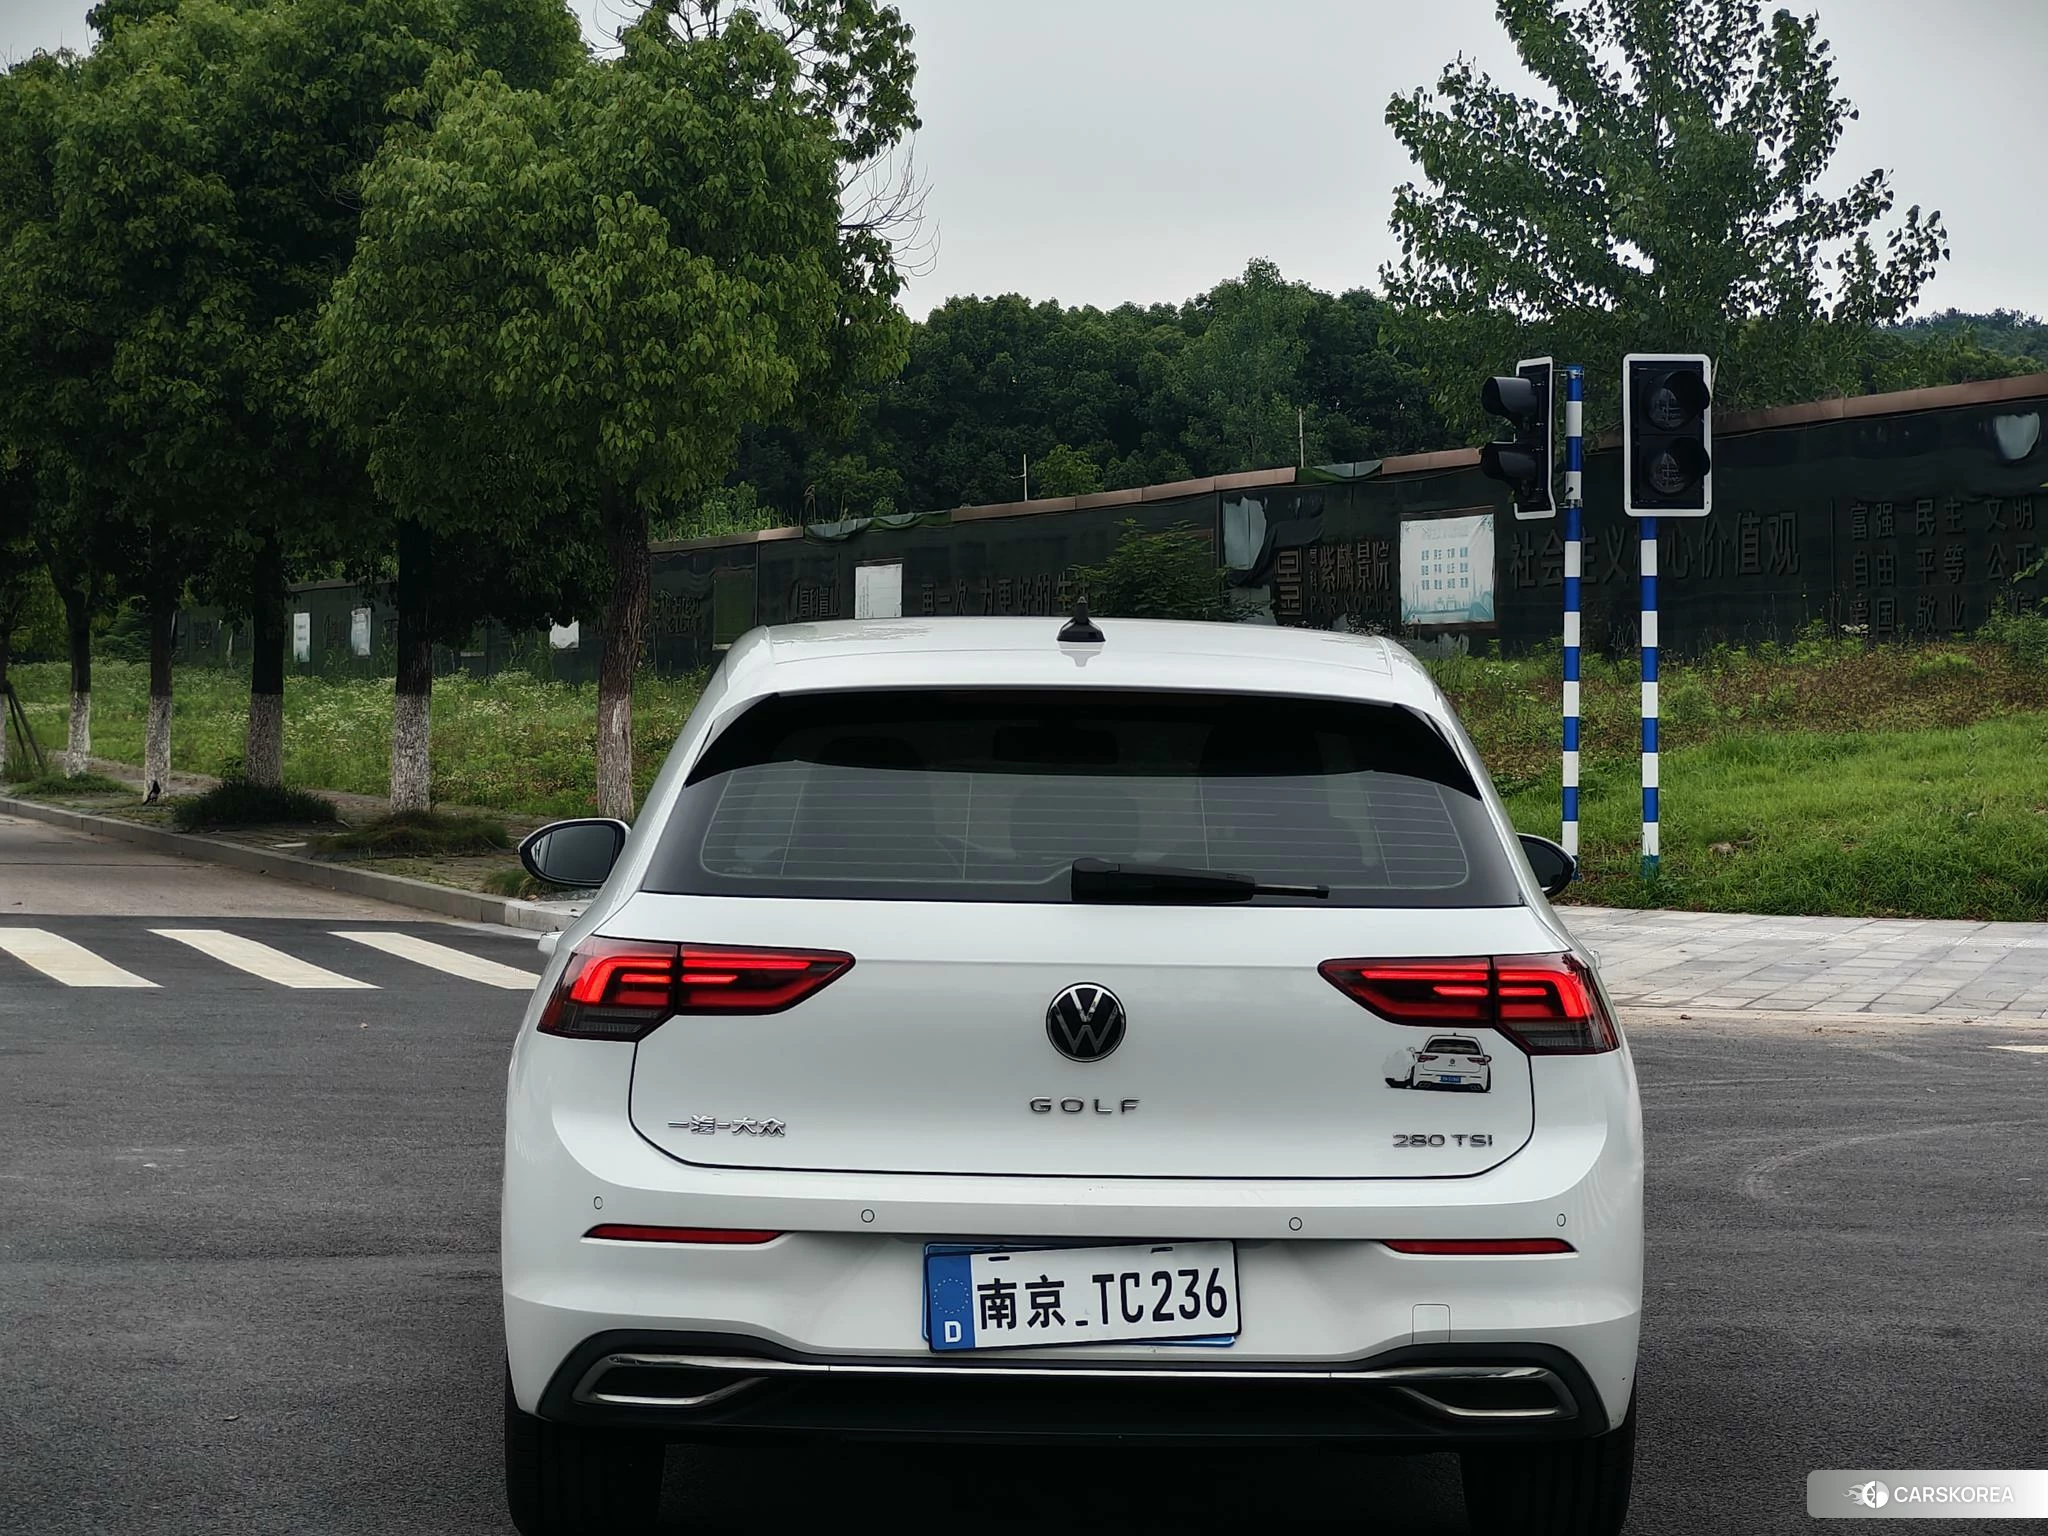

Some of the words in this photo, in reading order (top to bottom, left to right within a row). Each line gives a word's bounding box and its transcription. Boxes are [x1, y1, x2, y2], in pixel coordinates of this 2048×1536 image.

[1850, 501, 1896, 541] 富强
[1914, 496, 1968, 537] 民主
[1984, 496, 2036, 533] 文明
[1509, 510, 1802, 590] 社会主义心价值观
[1852, 550, 1896, 588] 自由
[1915, 543, 1968, 584] 平等
[1915, 592, 1968, 633] 敬业
[1029, 1096, 1141, 1114] GOLF
[1393, 1133, 1446, 1148] 280
[1451, 1133, 1493, 1148] TSI
[944, 1320, 962, 1343] D
